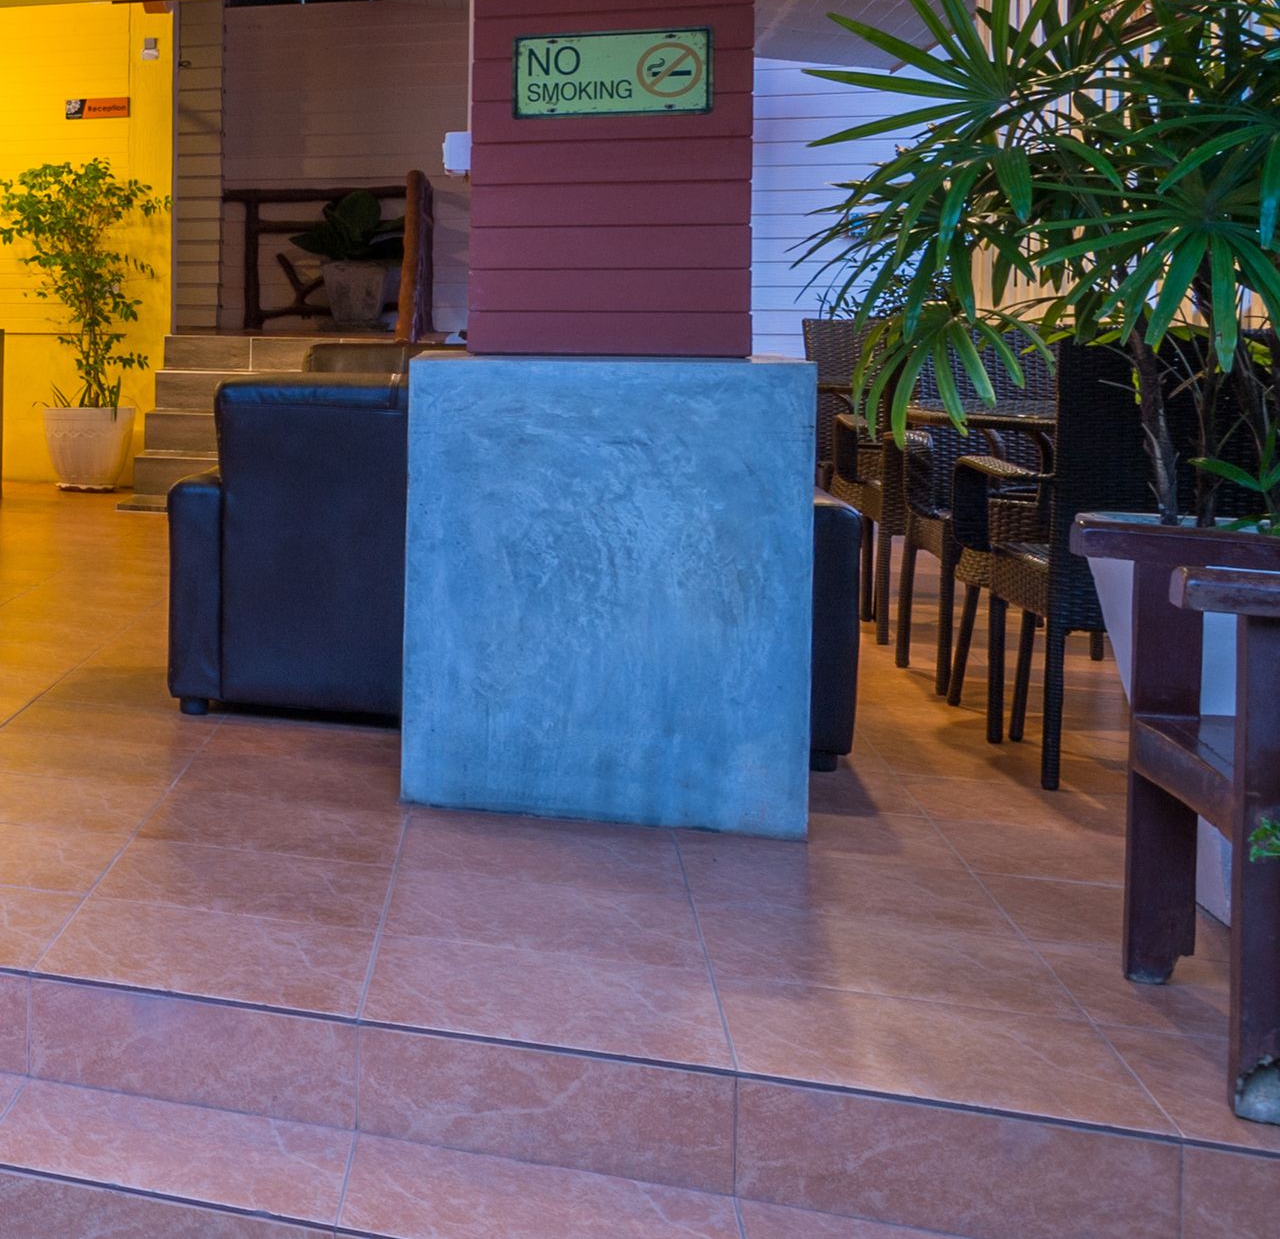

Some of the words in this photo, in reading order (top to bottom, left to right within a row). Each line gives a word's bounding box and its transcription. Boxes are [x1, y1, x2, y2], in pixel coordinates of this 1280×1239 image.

[528, 46, 581, 76] NO
[527, 79, 633, 103] SMOKING
[88, 104, 127, 113] Reception
